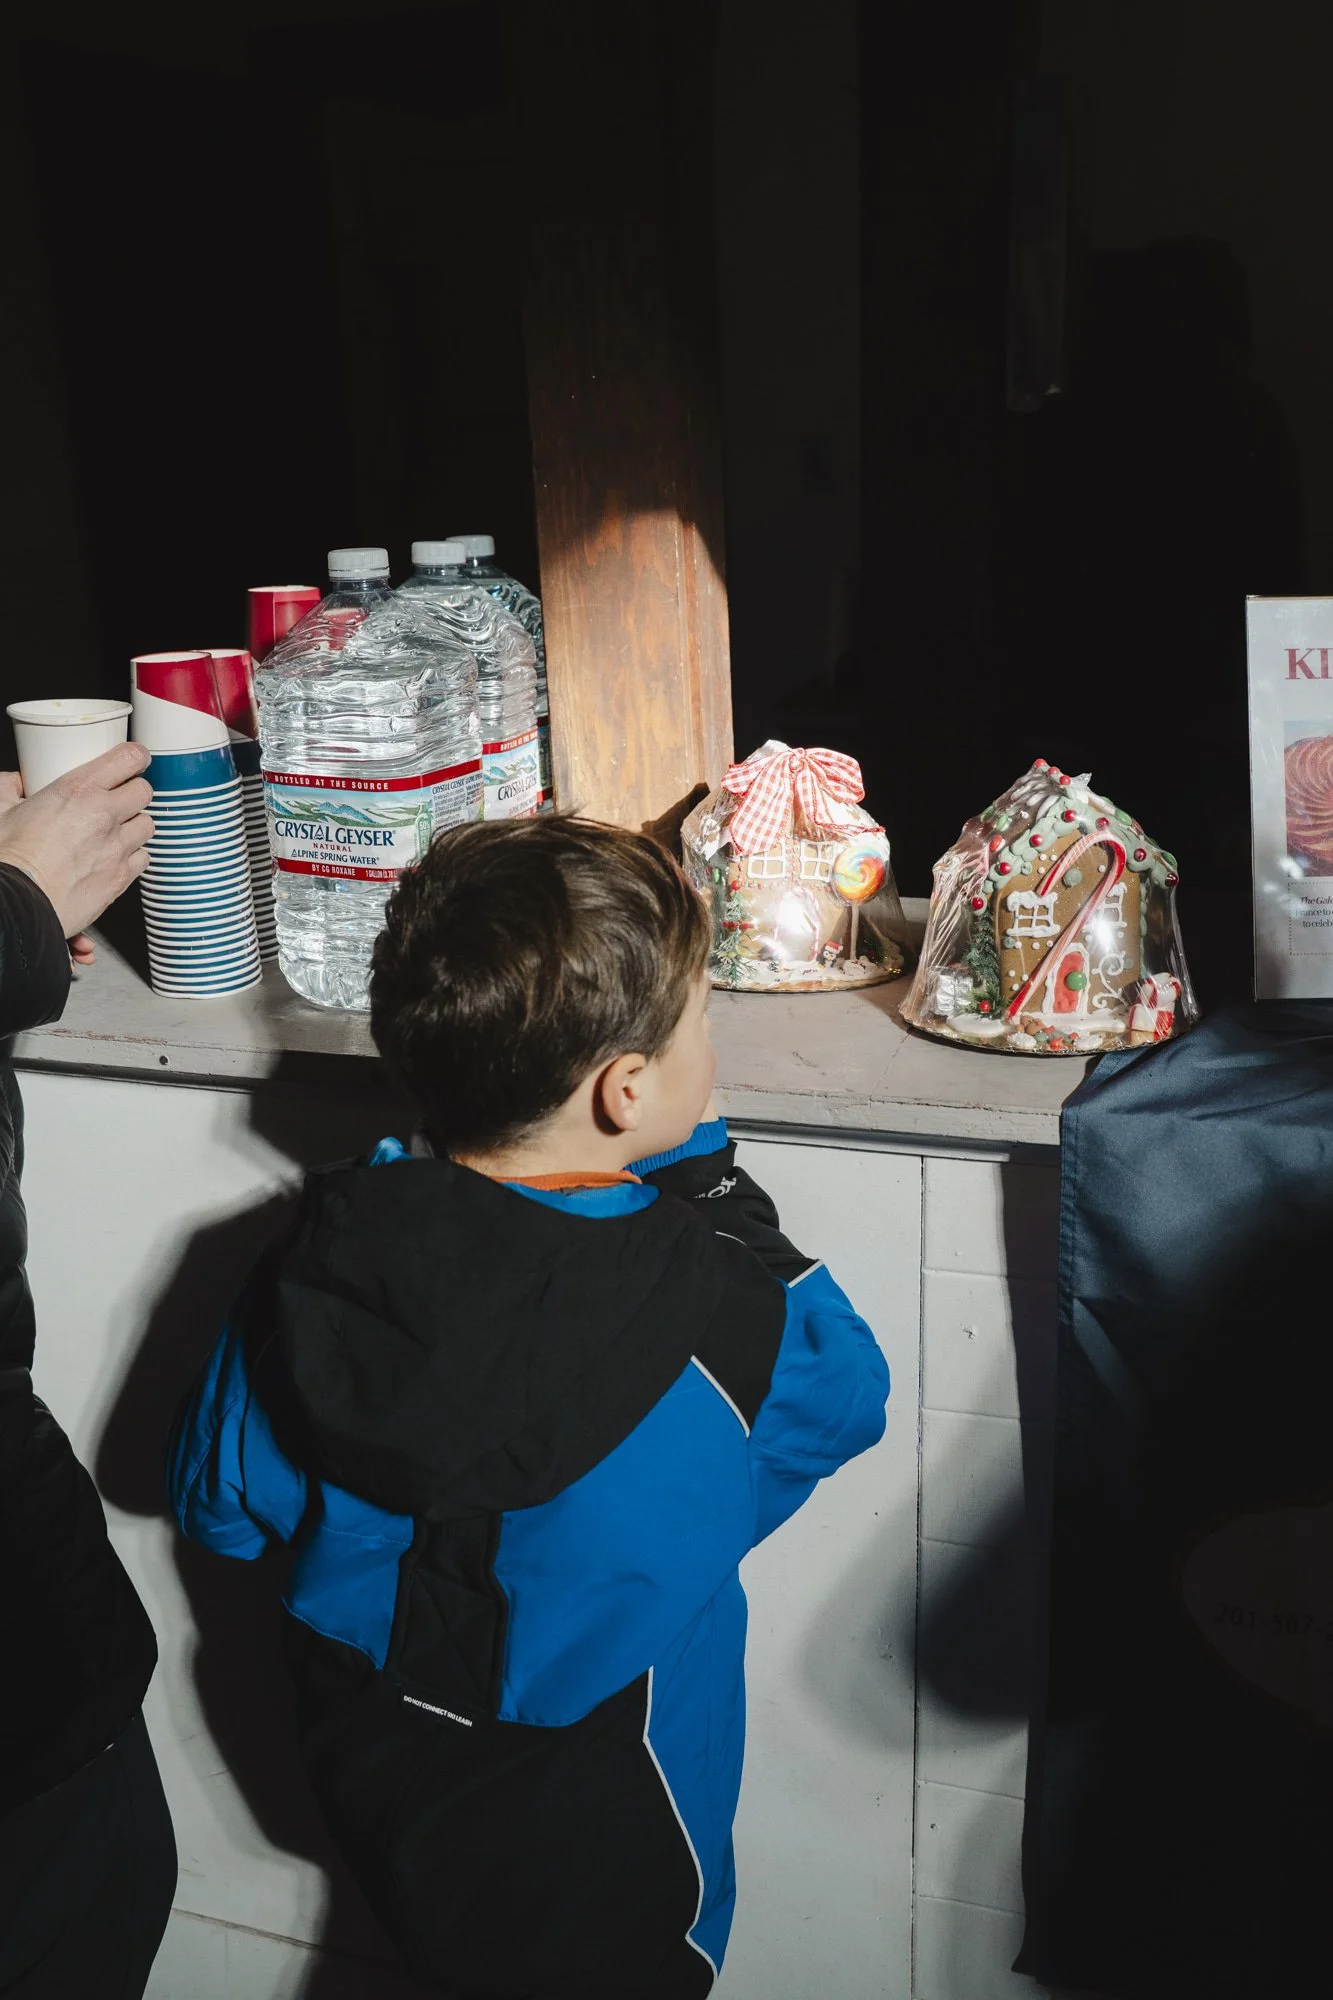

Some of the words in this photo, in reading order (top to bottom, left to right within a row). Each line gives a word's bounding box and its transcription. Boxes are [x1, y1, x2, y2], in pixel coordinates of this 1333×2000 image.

[274, 775, 310, 785] BOTTLED
[315, 778, 325, 787] AT
[330, 779, 346, 788] THE
[351, 781, 389, 790] SOURCE
[274, 820, 333, 843] CRYSTAL
[335, 827, 395, 847] GEYSER
[312, 842, 353, 853] NATURAL
[291, 848, 319, 860] ALPINE
[320, 851, 348, 863] SPRING
[349, 855, 378, 866] WATER
[311, 863, 320, 872] BY
[321, 865, 331, 873] CG
[331, 866, 356, 876] ROXANE
[1300, 896, 1315, 905] The
[1302, 920, 1311, 928] to
[403, 1695, 413, 1703] DO
[412, 1698, 423, 1708] NOT
[422, 1702, 448, 1717] CONNECT
